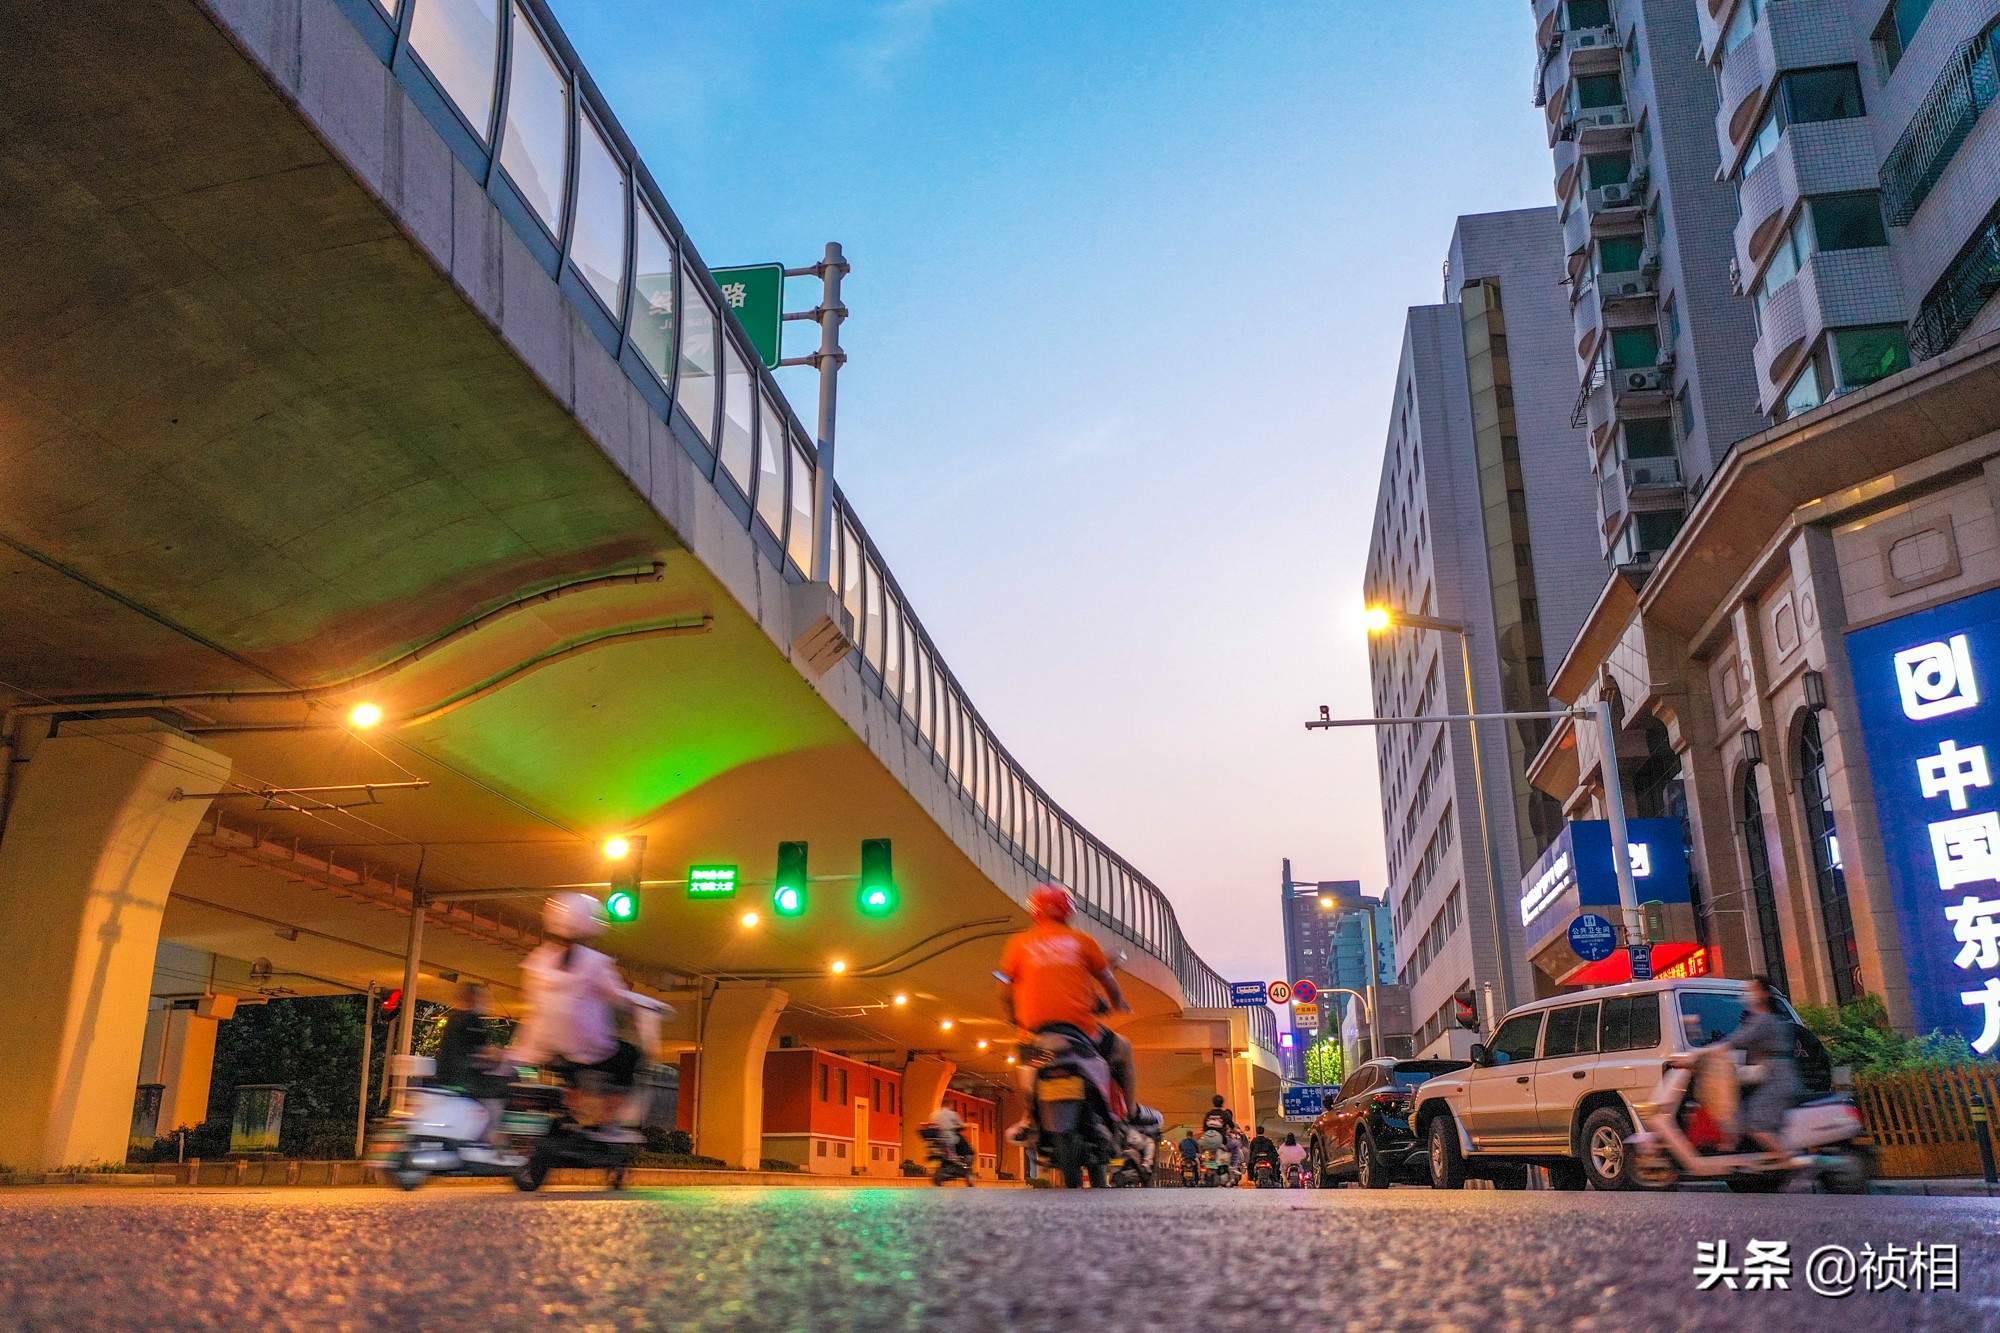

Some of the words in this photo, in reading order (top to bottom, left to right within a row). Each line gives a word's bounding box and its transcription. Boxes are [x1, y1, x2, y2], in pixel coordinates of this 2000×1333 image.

[1572, 926, 1610, 934] 公共卫生间
[1273, 987, 1287, 998] 40
